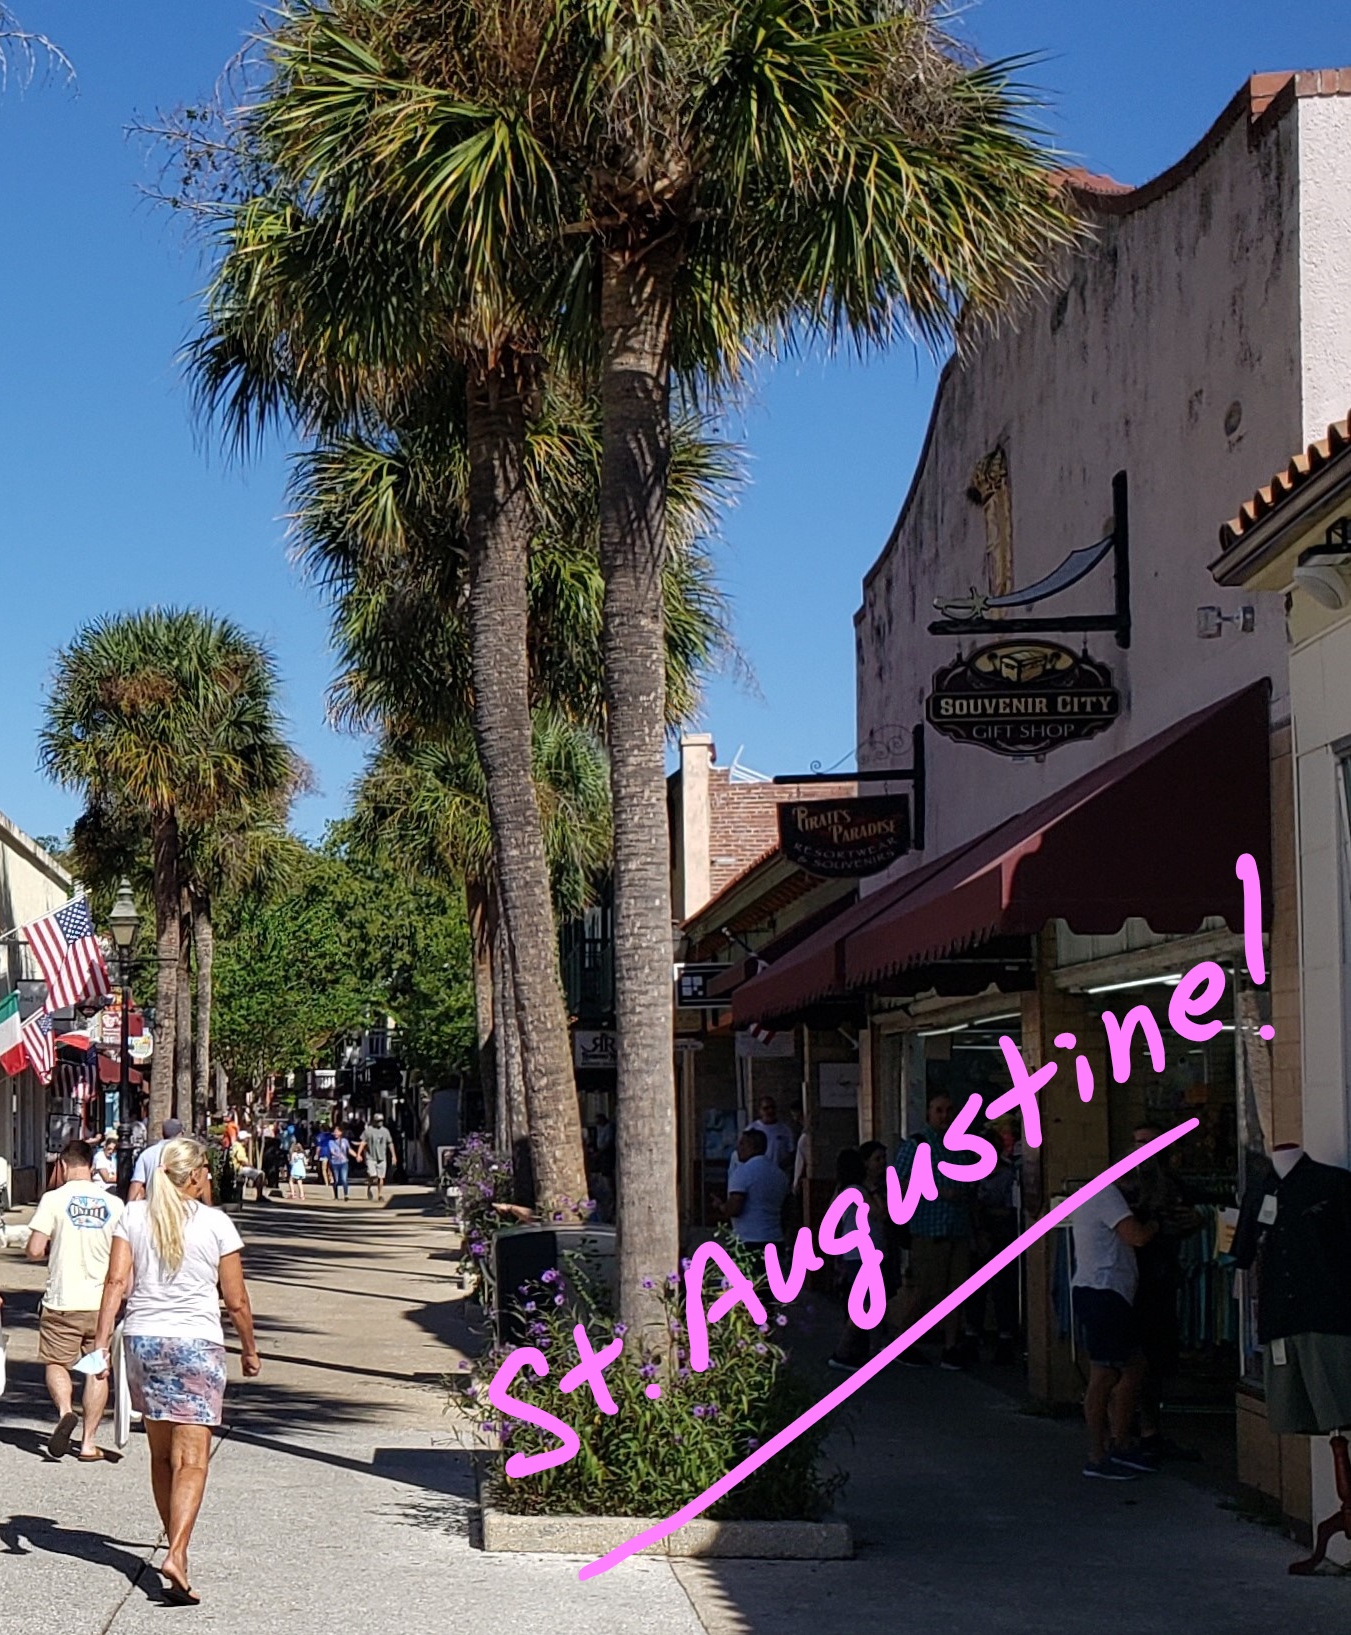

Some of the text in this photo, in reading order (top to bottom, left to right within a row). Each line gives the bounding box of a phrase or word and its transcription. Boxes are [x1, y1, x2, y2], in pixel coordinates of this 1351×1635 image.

[940, 695, 1112, 716] SOUVENIR CITY
[972, 723, 1075, 739] GIFT SHOP
[828, 819, 896, 844] PARADISE
[793, 836, 898, 860] RESORTWEAR
[813, 850, 896, 870] SOUVENIRS
